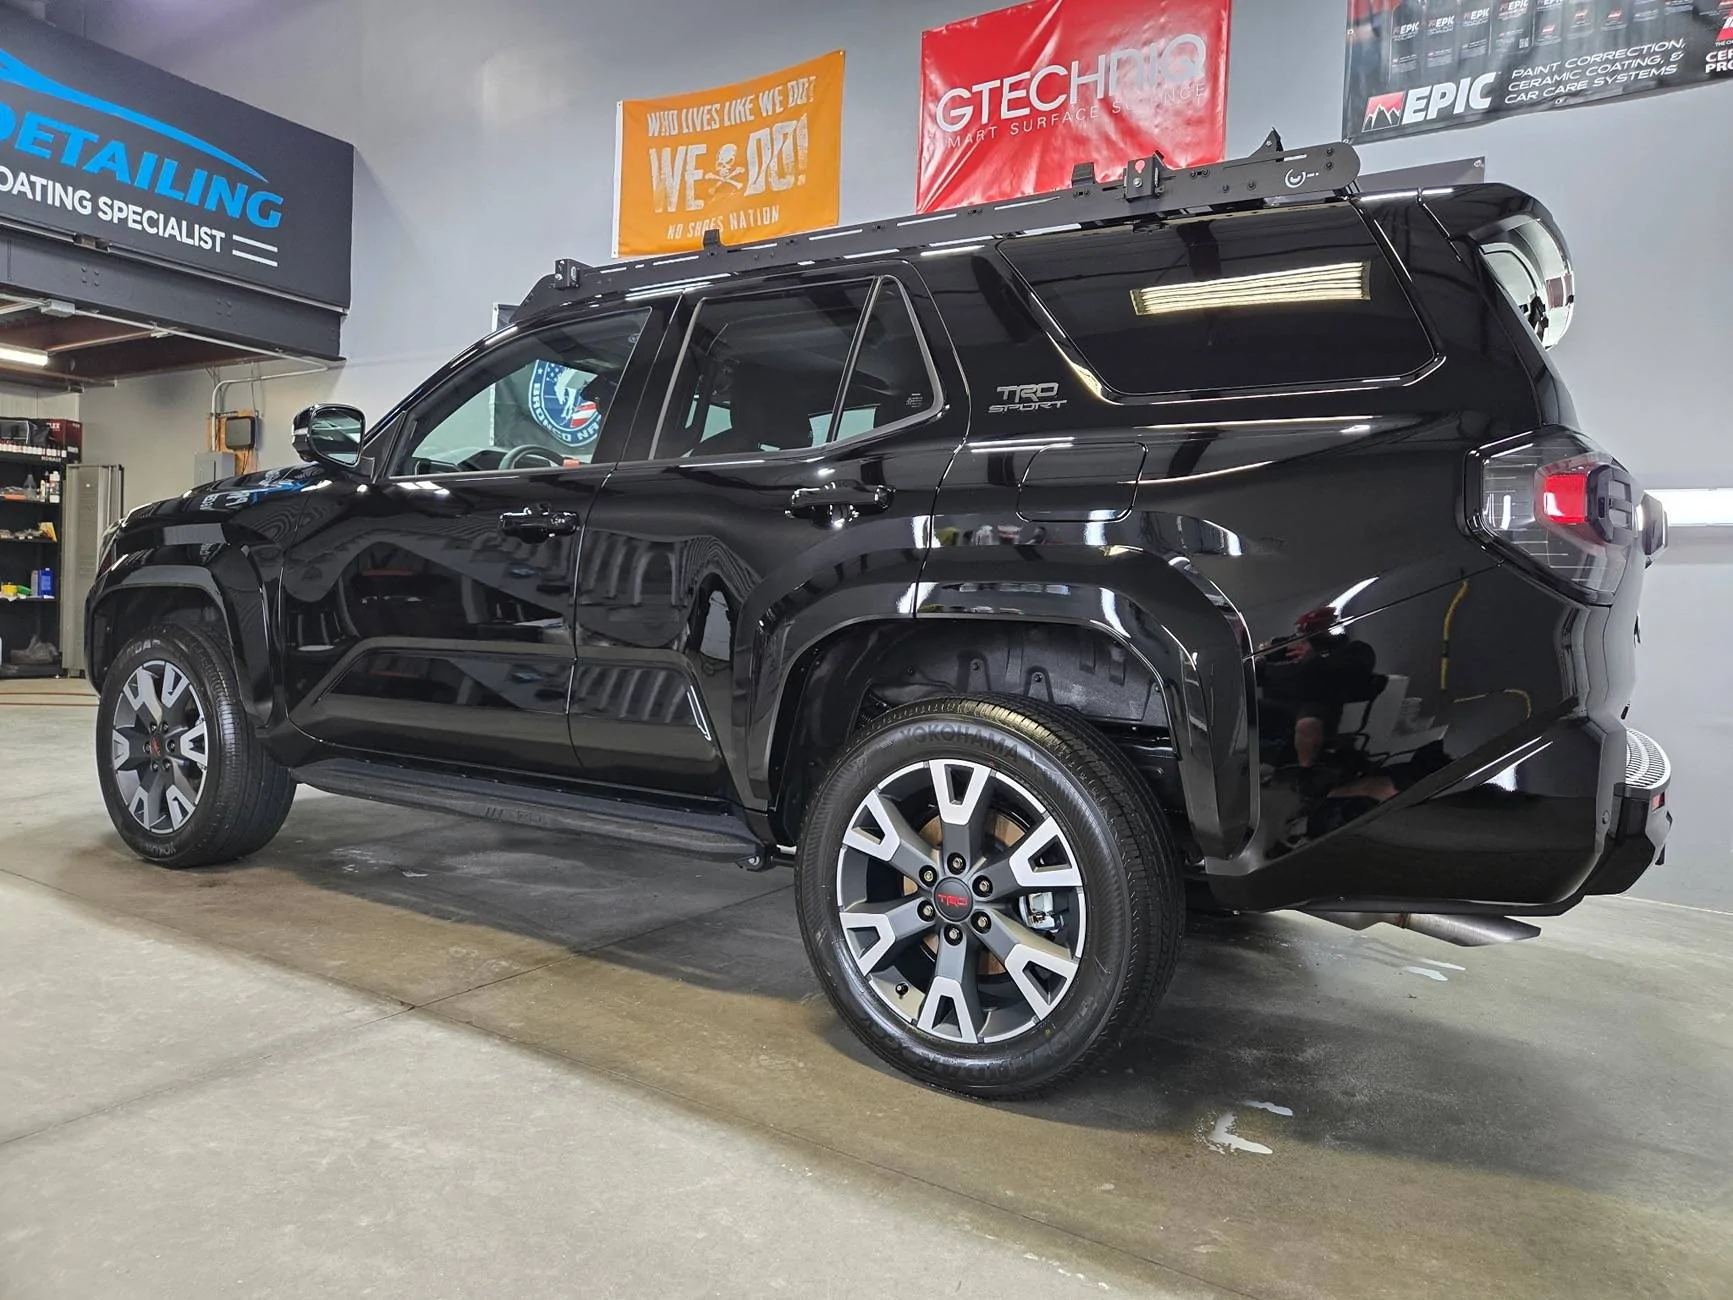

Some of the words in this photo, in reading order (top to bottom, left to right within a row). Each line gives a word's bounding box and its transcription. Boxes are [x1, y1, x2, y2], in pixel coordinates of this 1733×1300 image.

[1508, 70, 1582, 92] CERAMIC
[1586, 55, 1665, 77] COATING,
[1669, 51, 1685, 62] &
[1511, 61, 1561, 79] PAINT
[1565, 38, 1686, 68] CORRECTION,
[1401, 72, 1498, 125] EPIC
[1504, 88, 1538, 104] CAR
[1543, 80, 1589, 97] CARE
[1593, 64, 1678, 87] SYSTEMS
[647, 110, 678, 137] WHO
[682, 103, 720, 133] LIVES
[724, 94, 755, 126] LIKE
[759, 86, 783, 117] WE
[787, 76, 816, 108] DO?
[946, 126, 997, 149] MART
[1010, 105, 1099, 136] SURFACE
[1112, 83, 1206, 114] SNCE
[649, 143, 707, 213] WE
[743, 112, 809, 197] DO!
[97, 196, 225, 252] SPECIALIST
[667, 223, 684, 239] NO
[687, 215, 724, 238] SHOES
[729, 205, 780, 231] NATION
[532, 382, 572, 442] BRONCO
[577, 418, 599, 441] NA
[988, 399, 1067, 413] SPORT
[997, 382, 1059, 403] TRD
[901, 724, 1018, 763] YOKOHAMA
[937, 893, 968, 907] TRD
